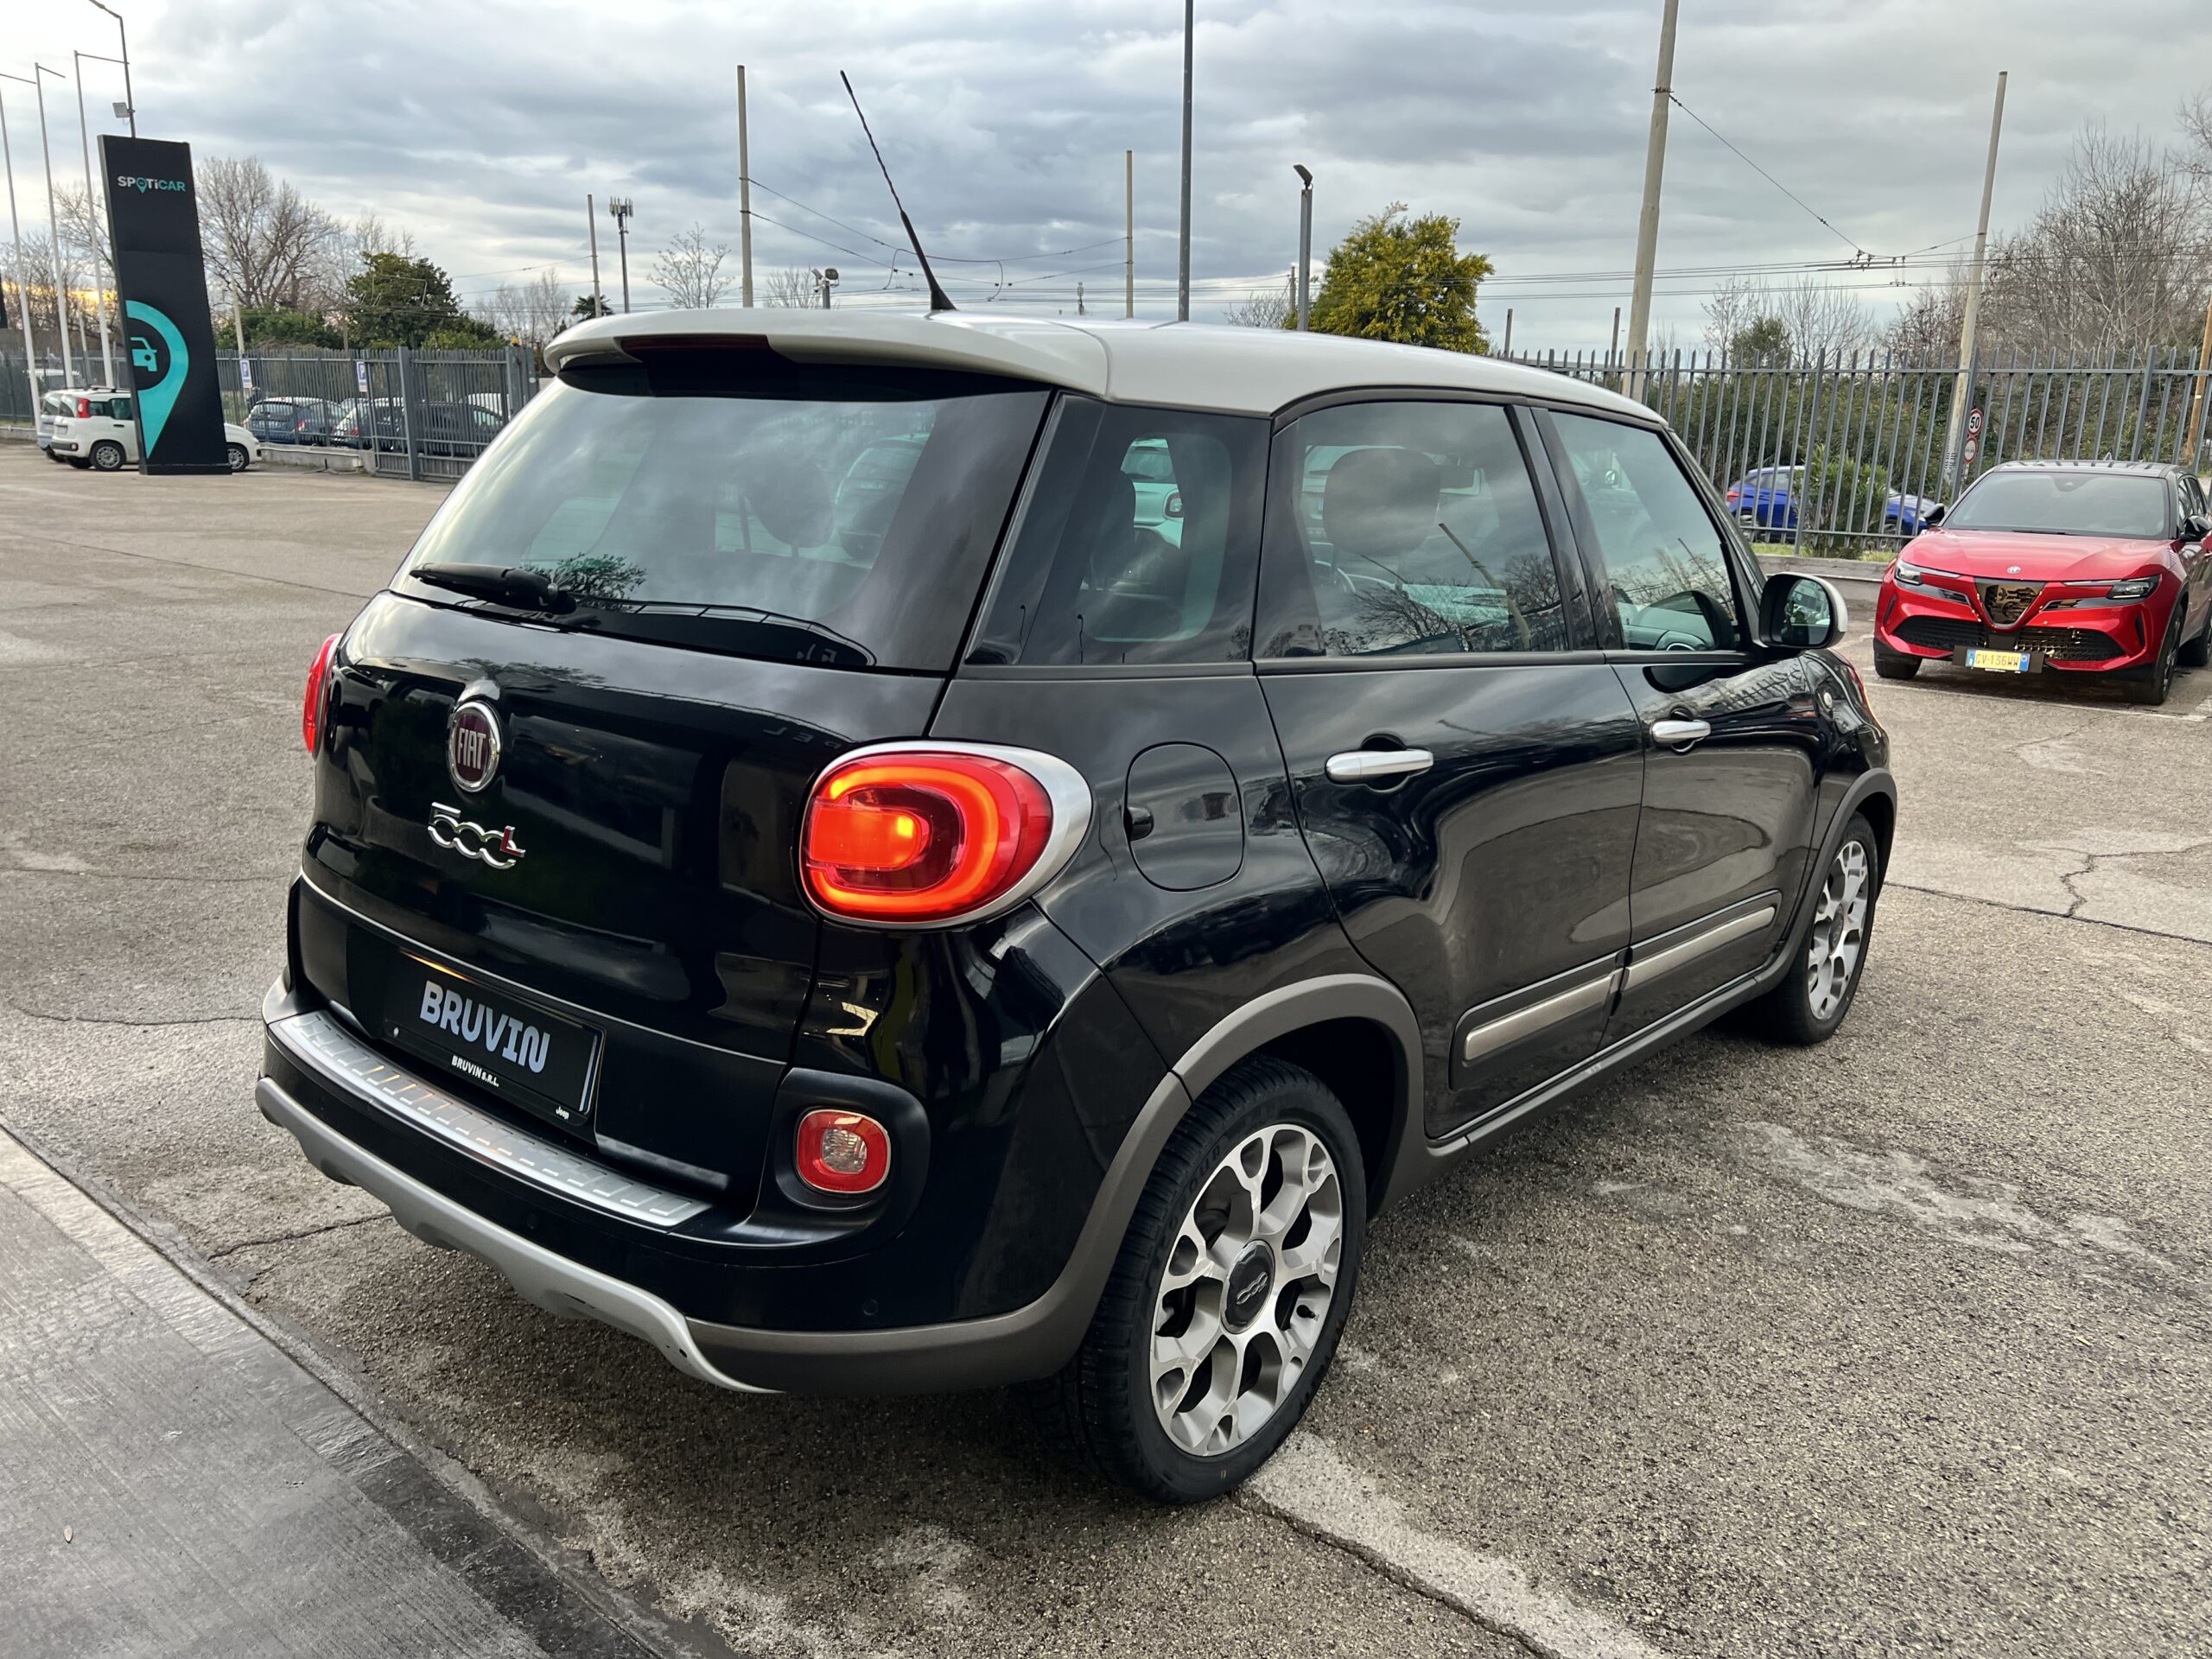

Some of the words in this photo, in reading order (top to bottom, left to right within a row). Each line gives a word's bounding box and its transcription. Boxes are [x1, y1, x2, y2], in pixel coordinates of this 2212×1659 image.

[1970, 416, 1980, 429] 50
[457, 728, 486, 770] FIAT
[419, 980, 550, 1073] BRUVIN
[451, 1054, 482, 1078] BRUVIN
[481, 1071, 499, 1087] S.R.L.
